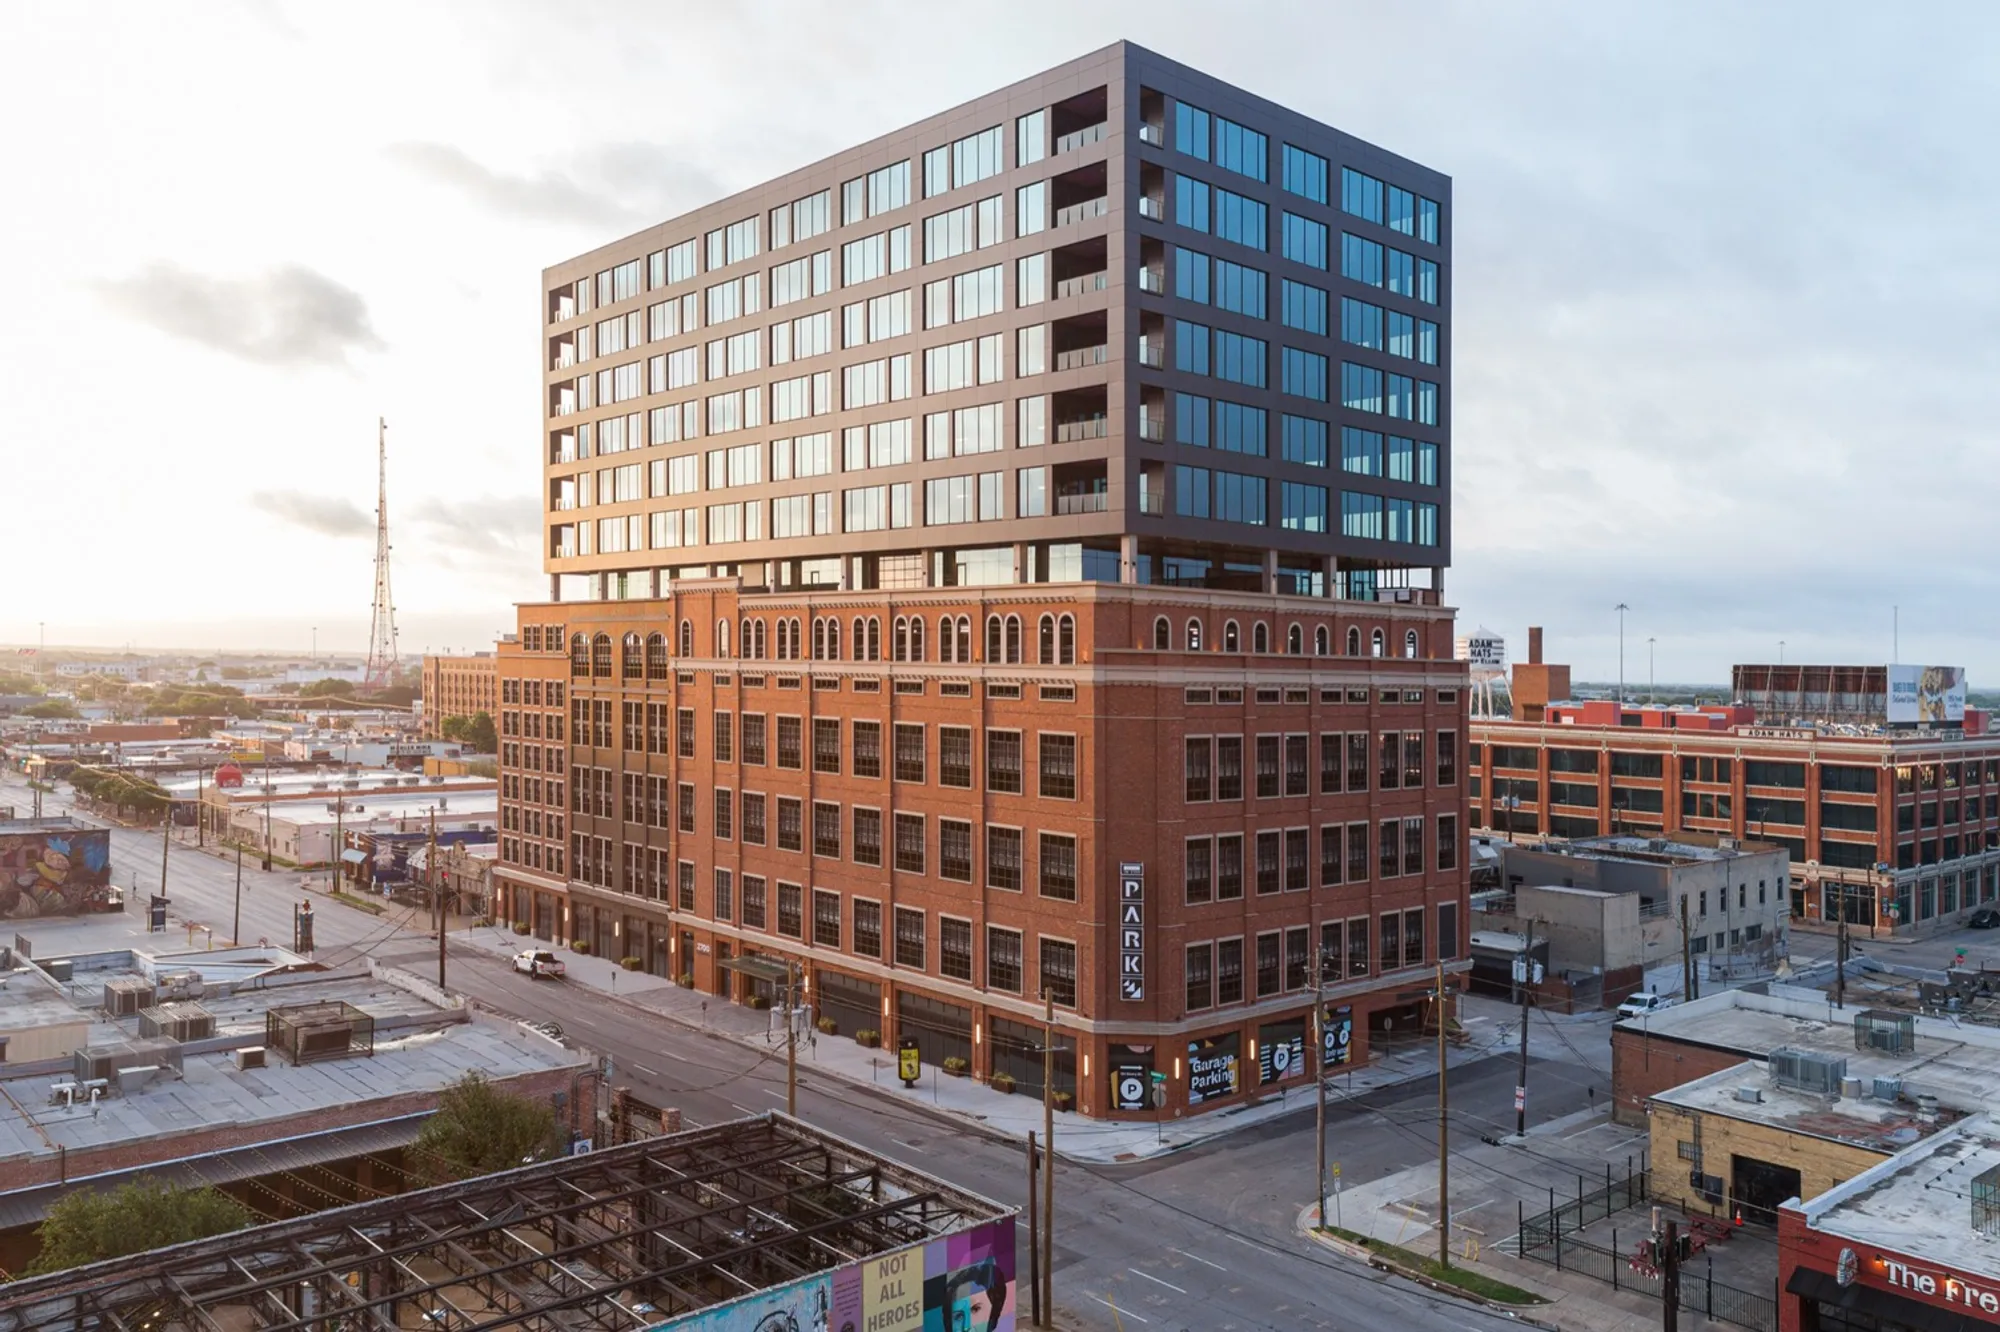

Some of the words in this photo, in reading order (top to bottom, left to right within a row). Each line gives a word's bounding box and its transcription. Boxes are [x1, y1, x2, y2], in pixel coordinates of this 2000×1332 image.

[1469, 640, 1492, 648] ADAM
[1471, 649, 1491, 657] HATS
[1124, 881, 1141, 972] PARK
[1193, 1055, 1234, 1073] Garage
[1279, 1053, 1285, 1065] P
[1191, 1069, 1235, 1089] Parking
[1128, 1084, 1137, 1095] P
[880, 1253, 908, 1279] NOT
[880, 1280, 905, 1304] ALL
[1884, 1260, 1936, 1296] The
[1946, 1278, 1999, 1314] Fre
[868, 1301, 920, 1332] HEROES
